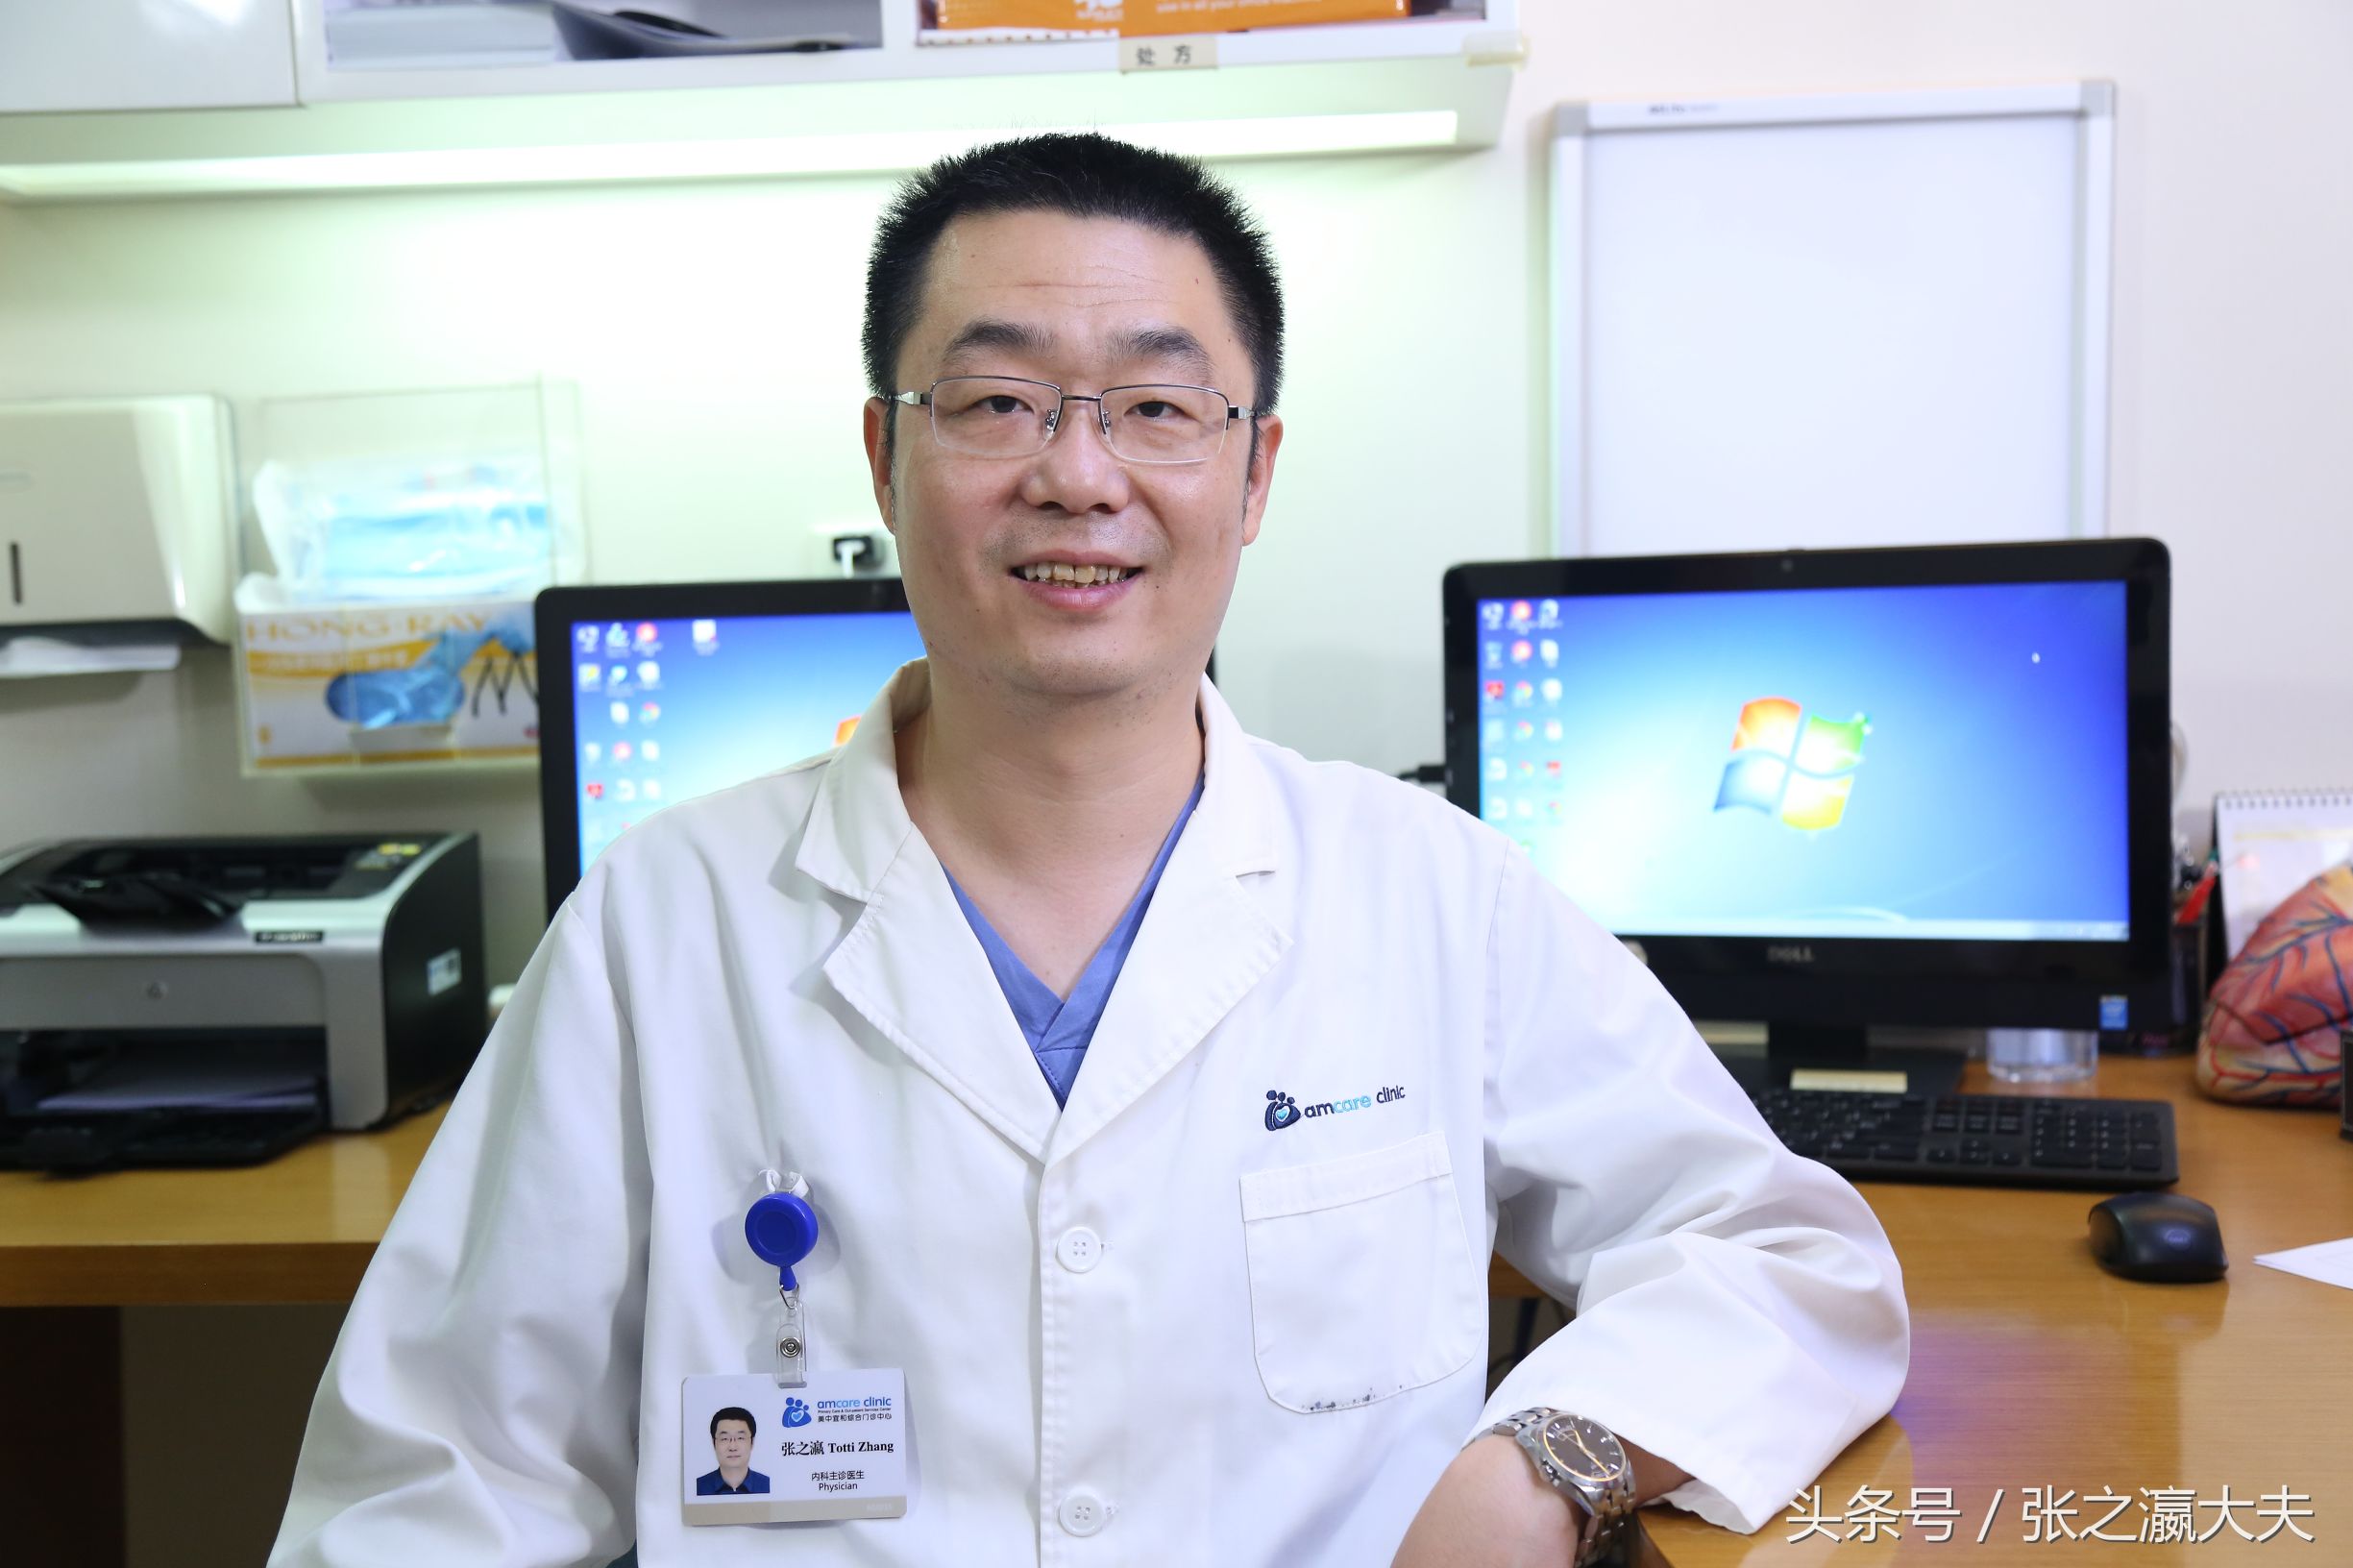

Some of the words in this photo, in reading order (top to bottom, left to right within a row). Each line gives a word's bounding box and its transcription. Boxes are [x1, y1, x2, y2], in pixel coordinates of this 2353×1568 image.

[1136, 44, 1192, 66] 处方
[1304, 1095, 1372, 1118] amcare
[1376, 1085, 1407, 1104] clinic
[817, 1399, 861, 1409] amcare
[863, 1396, 892, 1408] clinic
[818, 1412, 893, 1423] 美中宜和综合门诊中心
[781, 1440, 825, 1457] 张之瀛
[827, 1442, 855, 1454] Totti
[858, 1441, 895, 1454] Zhang
[811, 1470, 866, 1482] 内科主诊医生
[819, 1482, 858, 1493] Physician
